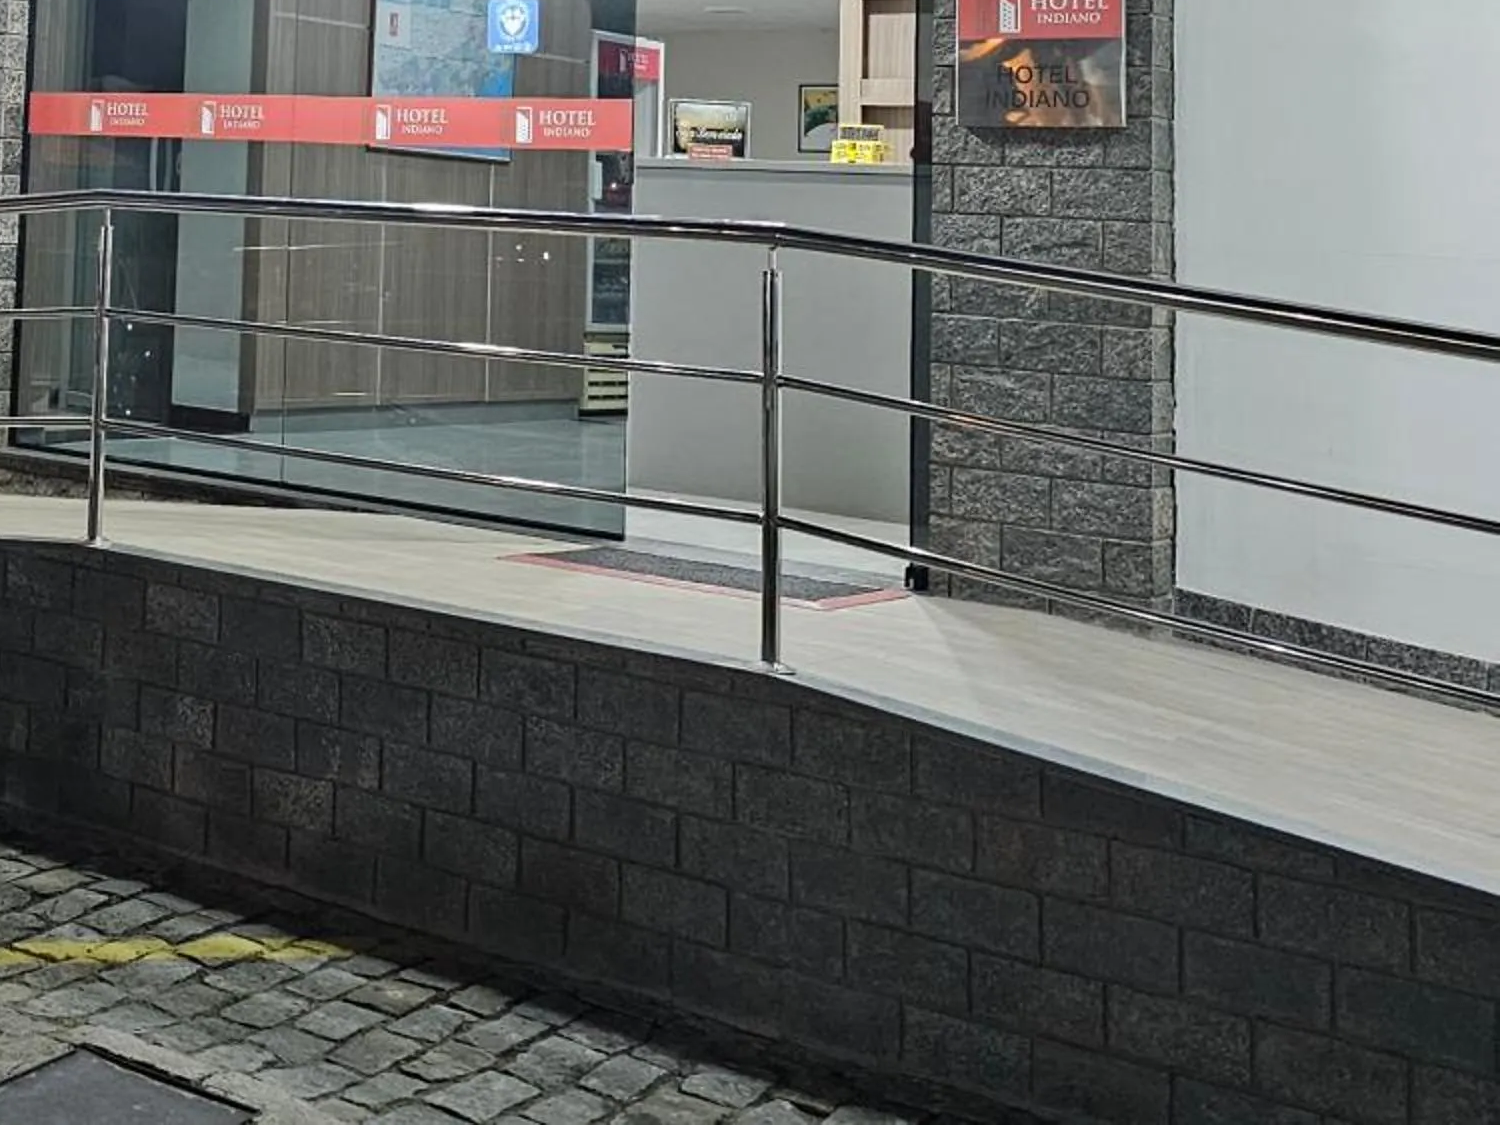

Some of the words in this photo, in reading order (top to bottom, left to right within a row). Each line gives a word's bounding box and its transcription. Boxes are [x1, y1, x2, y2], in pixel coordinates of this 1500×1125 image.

[1036, 12, 1101, 24] INDIANO
[997, 64, 1078, 84] HOTEL
[986, 89, 1090, 109] INDIANO
[107, 102, 149, 117] HOTEL
[220, 104, 264, 119] HOTEL
[396, 108, 448, 124] HOTEL
[539, 110, 596, 126] HOTEL
